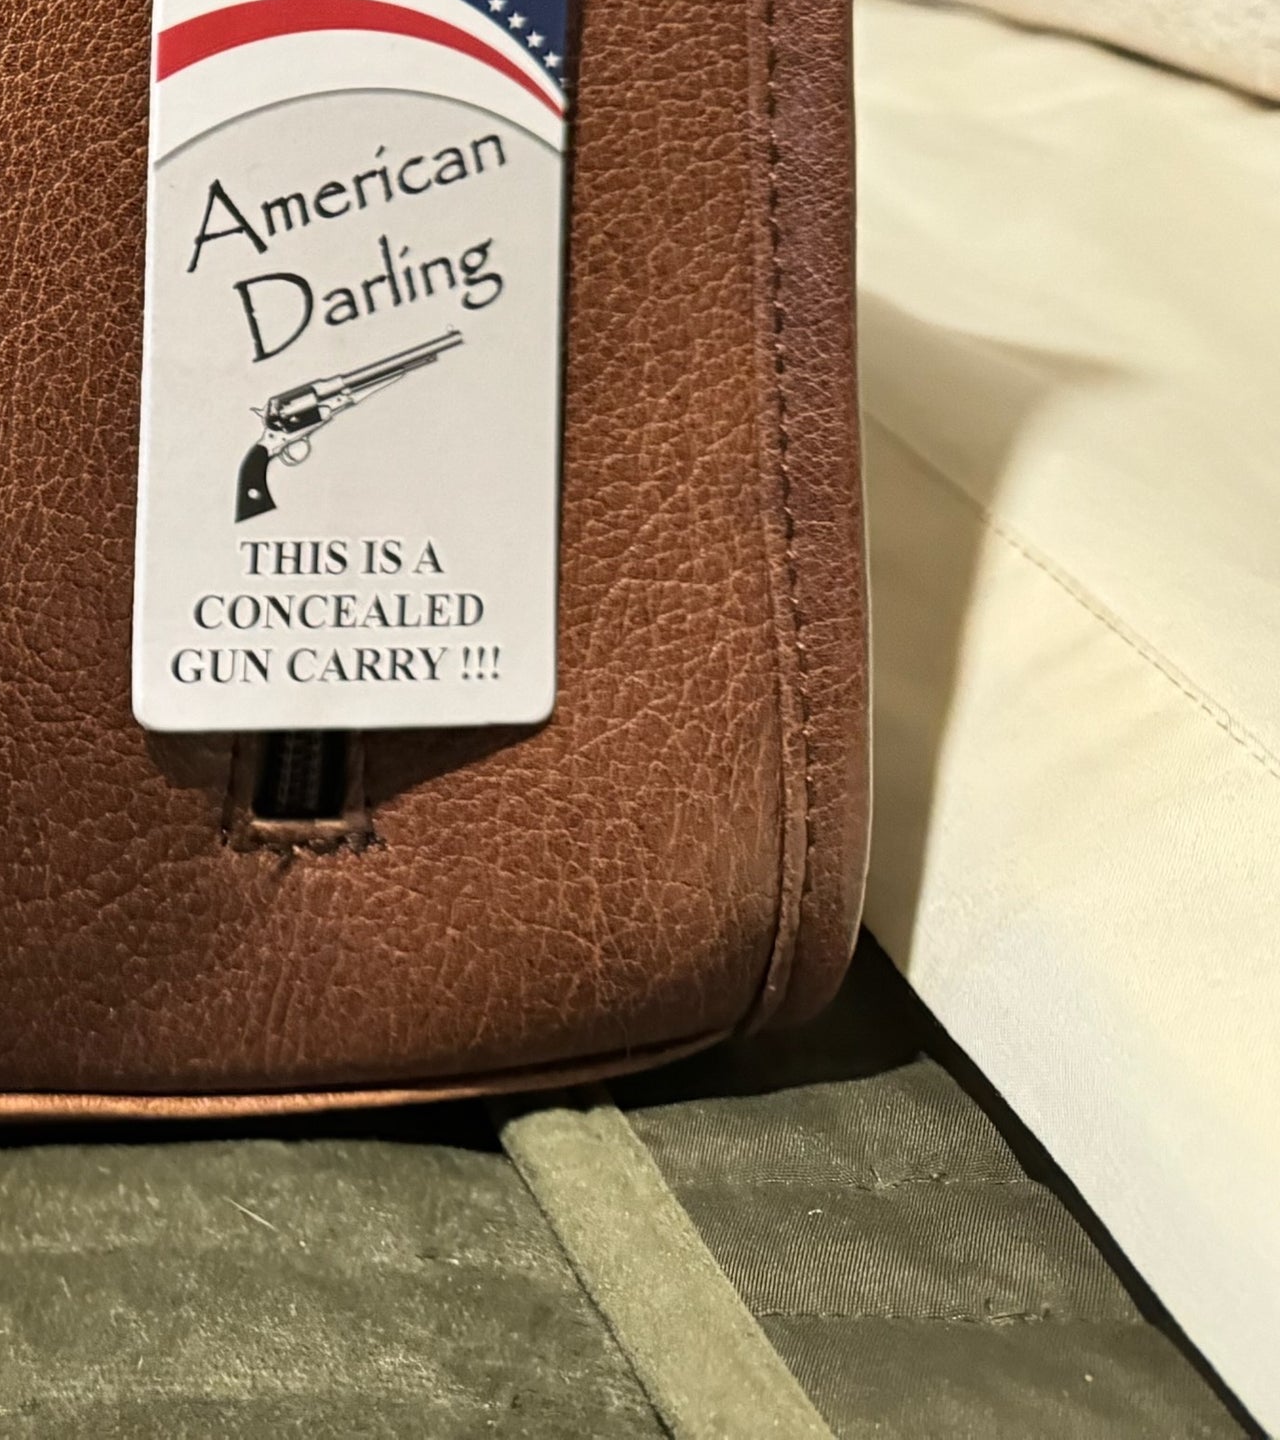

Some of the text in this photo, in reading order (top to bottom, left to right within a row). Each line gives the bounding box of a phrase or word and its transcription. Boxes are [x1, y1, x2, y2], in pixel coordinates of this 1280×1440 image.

[187, 133, 507, 273] American
[232, 234, 506, 363] Darling
[239, 539, 445, 576] THIS IS A
[193, 592, 485, 630] CONCEALED
[170, 645, 502, 684] GUN CARRY !!!
